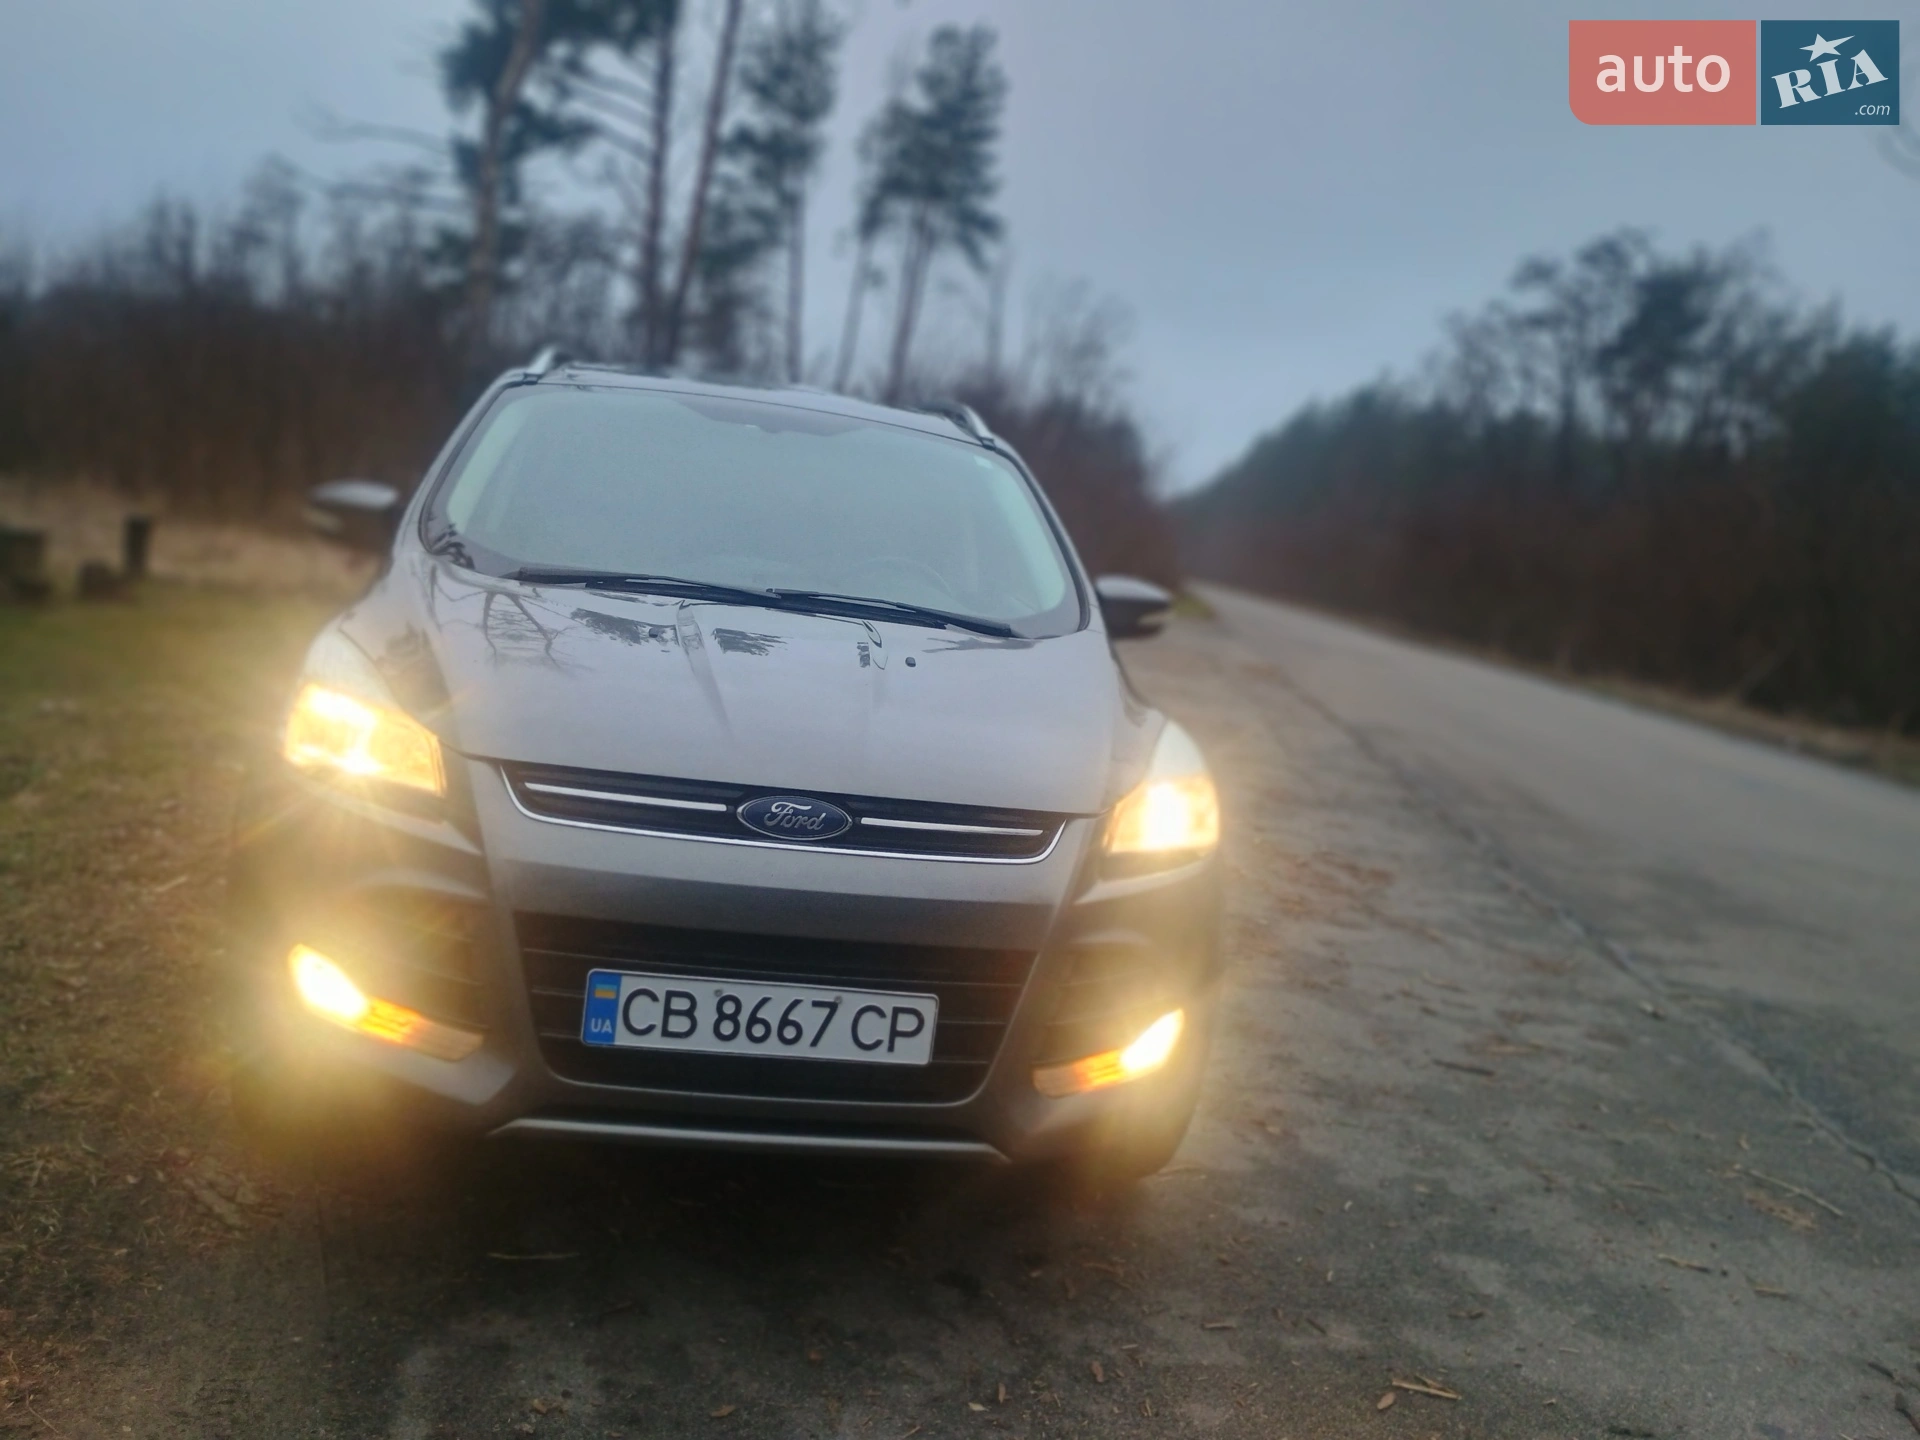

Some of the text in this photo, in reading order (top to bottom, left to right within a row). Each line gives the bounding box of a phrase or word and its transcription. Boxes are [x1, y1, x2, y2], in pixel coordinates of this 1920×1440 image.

[763, 801, 827, 831] Ford
[591, 1018, 612, 1034] UA
[622, 988, 925, 1053] CB 8667 CP
